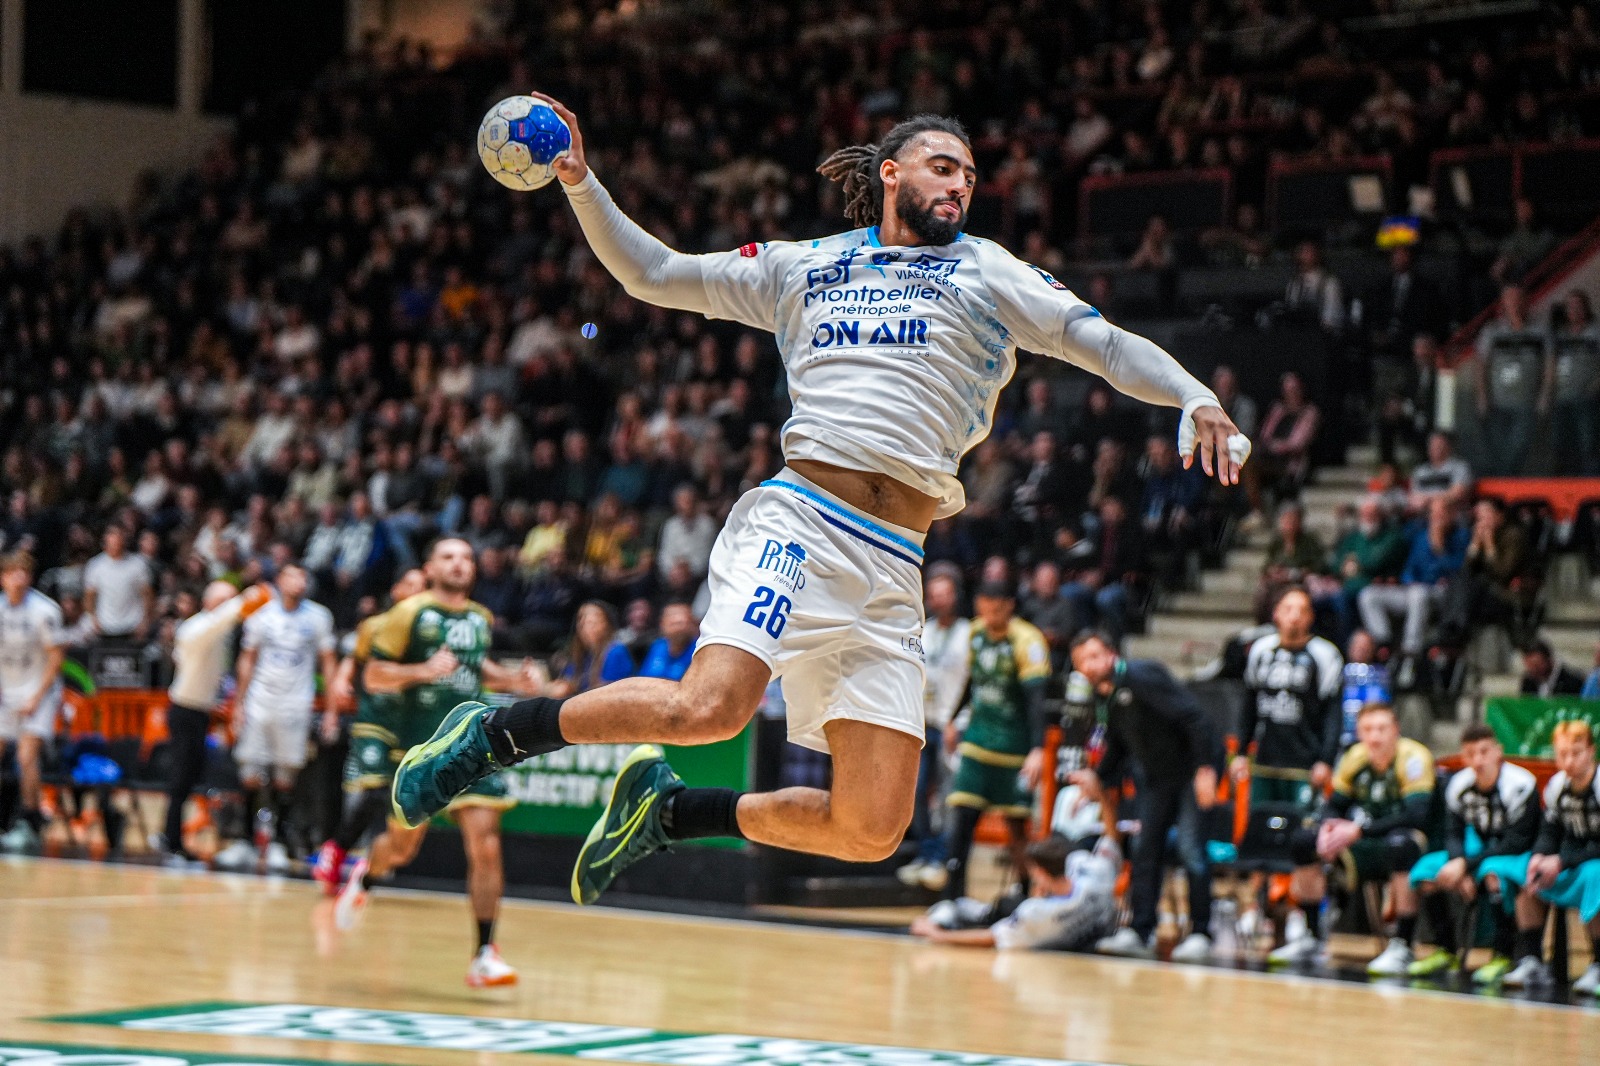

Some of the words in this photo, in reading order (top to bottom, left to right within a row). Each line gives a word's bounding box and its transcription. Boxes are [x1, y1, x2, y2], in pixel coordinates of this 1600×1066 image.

[810, 320, 860, 348] ON
[867, 318, 929, 345] AIR
[742, 585, 792, 640] 26
